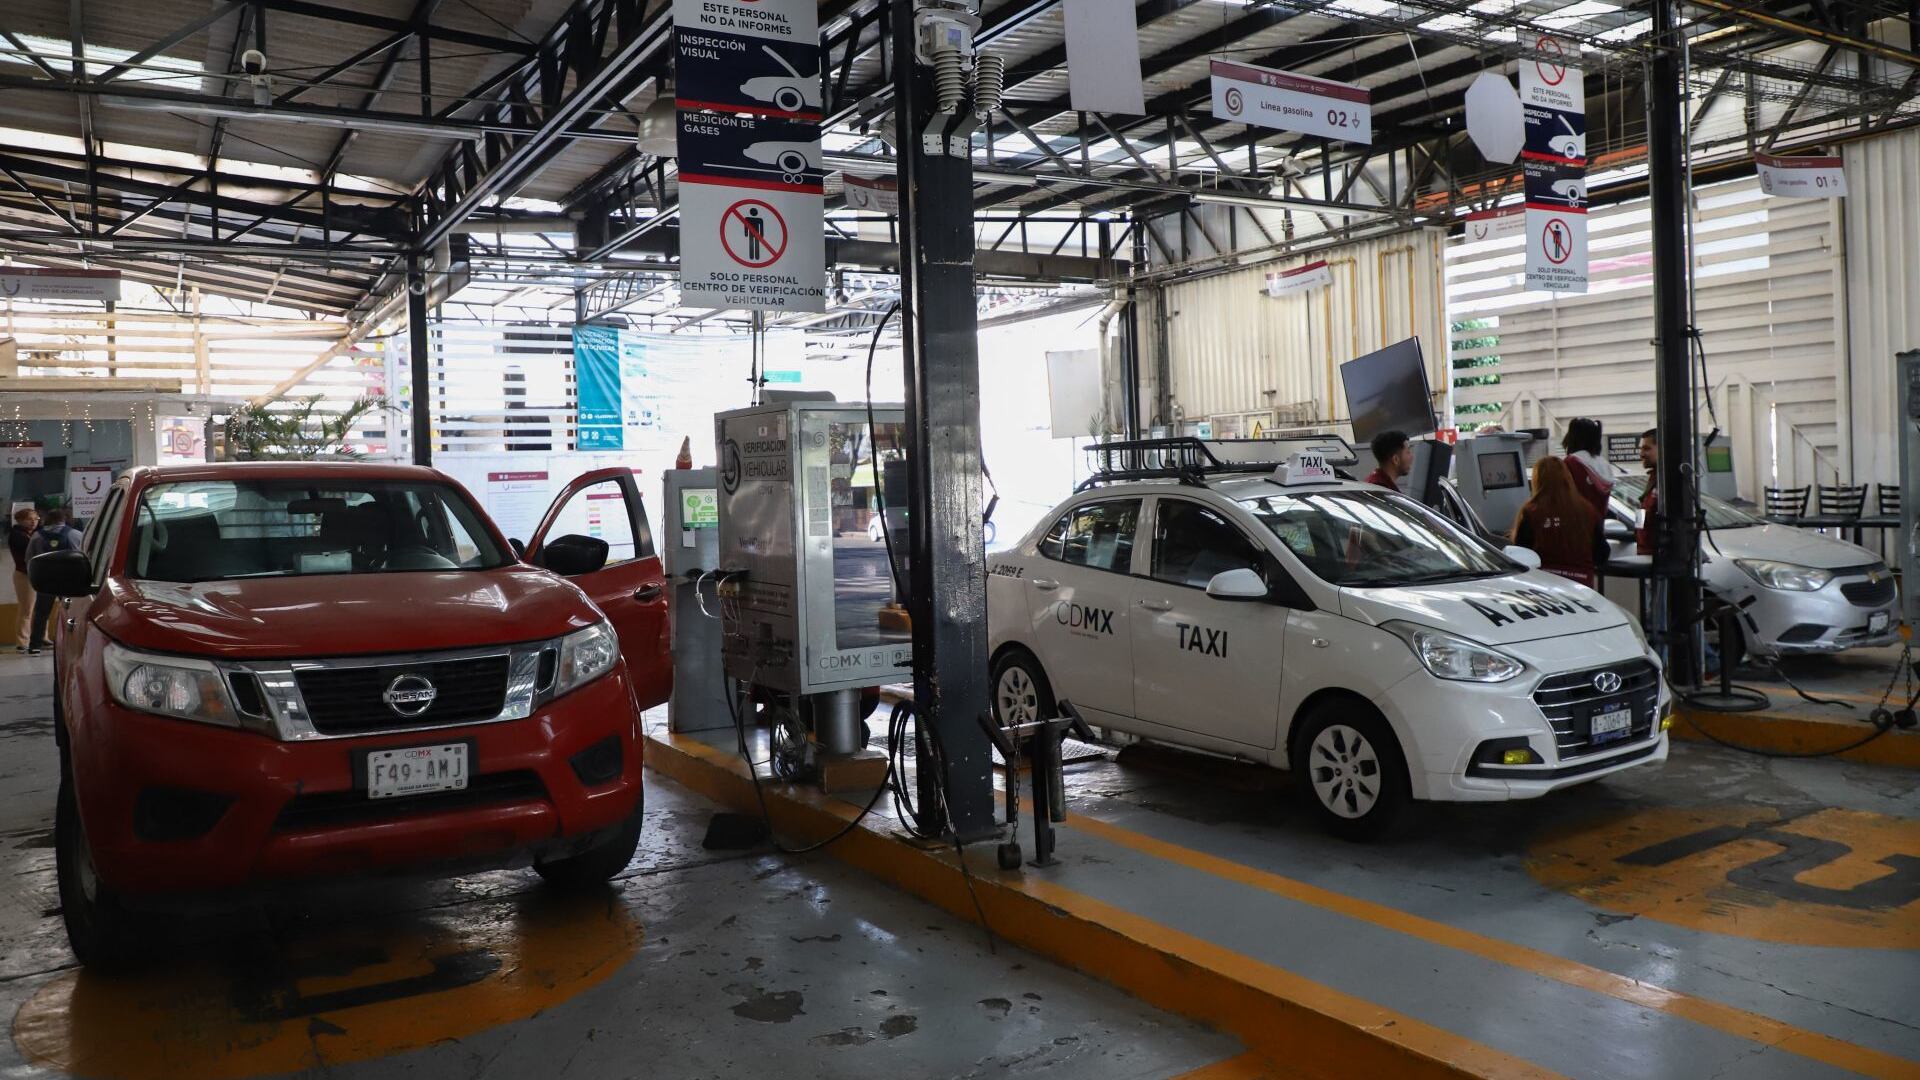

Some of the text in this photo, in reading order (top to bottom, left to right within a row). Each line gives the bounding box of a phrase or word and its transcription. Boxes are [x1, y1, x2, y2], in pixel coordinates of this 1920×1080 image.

[704, 2, 788, 23] ESTE PERSONAL
[700, 14, 792, 35] NO DA INFORMES
[680, 34, 746, 52] INSPECCIÓN
[680, 46, 720, 60] VISUAL
[684, 113, 755, 128] MEDICIÓN DE
[1282, 106, 1313, 118] gasolina
[1328, 110, 1347, 127] 02
[684, 124, 720, 135] GASES
[710, 272, 798, 284] SOLO PERSONAL
[684, 282, 823, 296] CENTRO DE VERIFICACIÓN
[724, 295, 785, 306] VEHICULAR
[744, 460, 787, 476] VEHICULAR
[1301, 457, 1322, 468] TAXI
[1057, 601, 1114, 635] CDMX
[1462, 598, 1515, 627] A
[1176, 622, 1227, 658] TAXI
[820, 654, 861, 669] CDMX
[390, 691, 433, 700] NISSAN
[405, 749, 432, 758] CDMX
[375, 758, 461, 785] F49-AMJ
